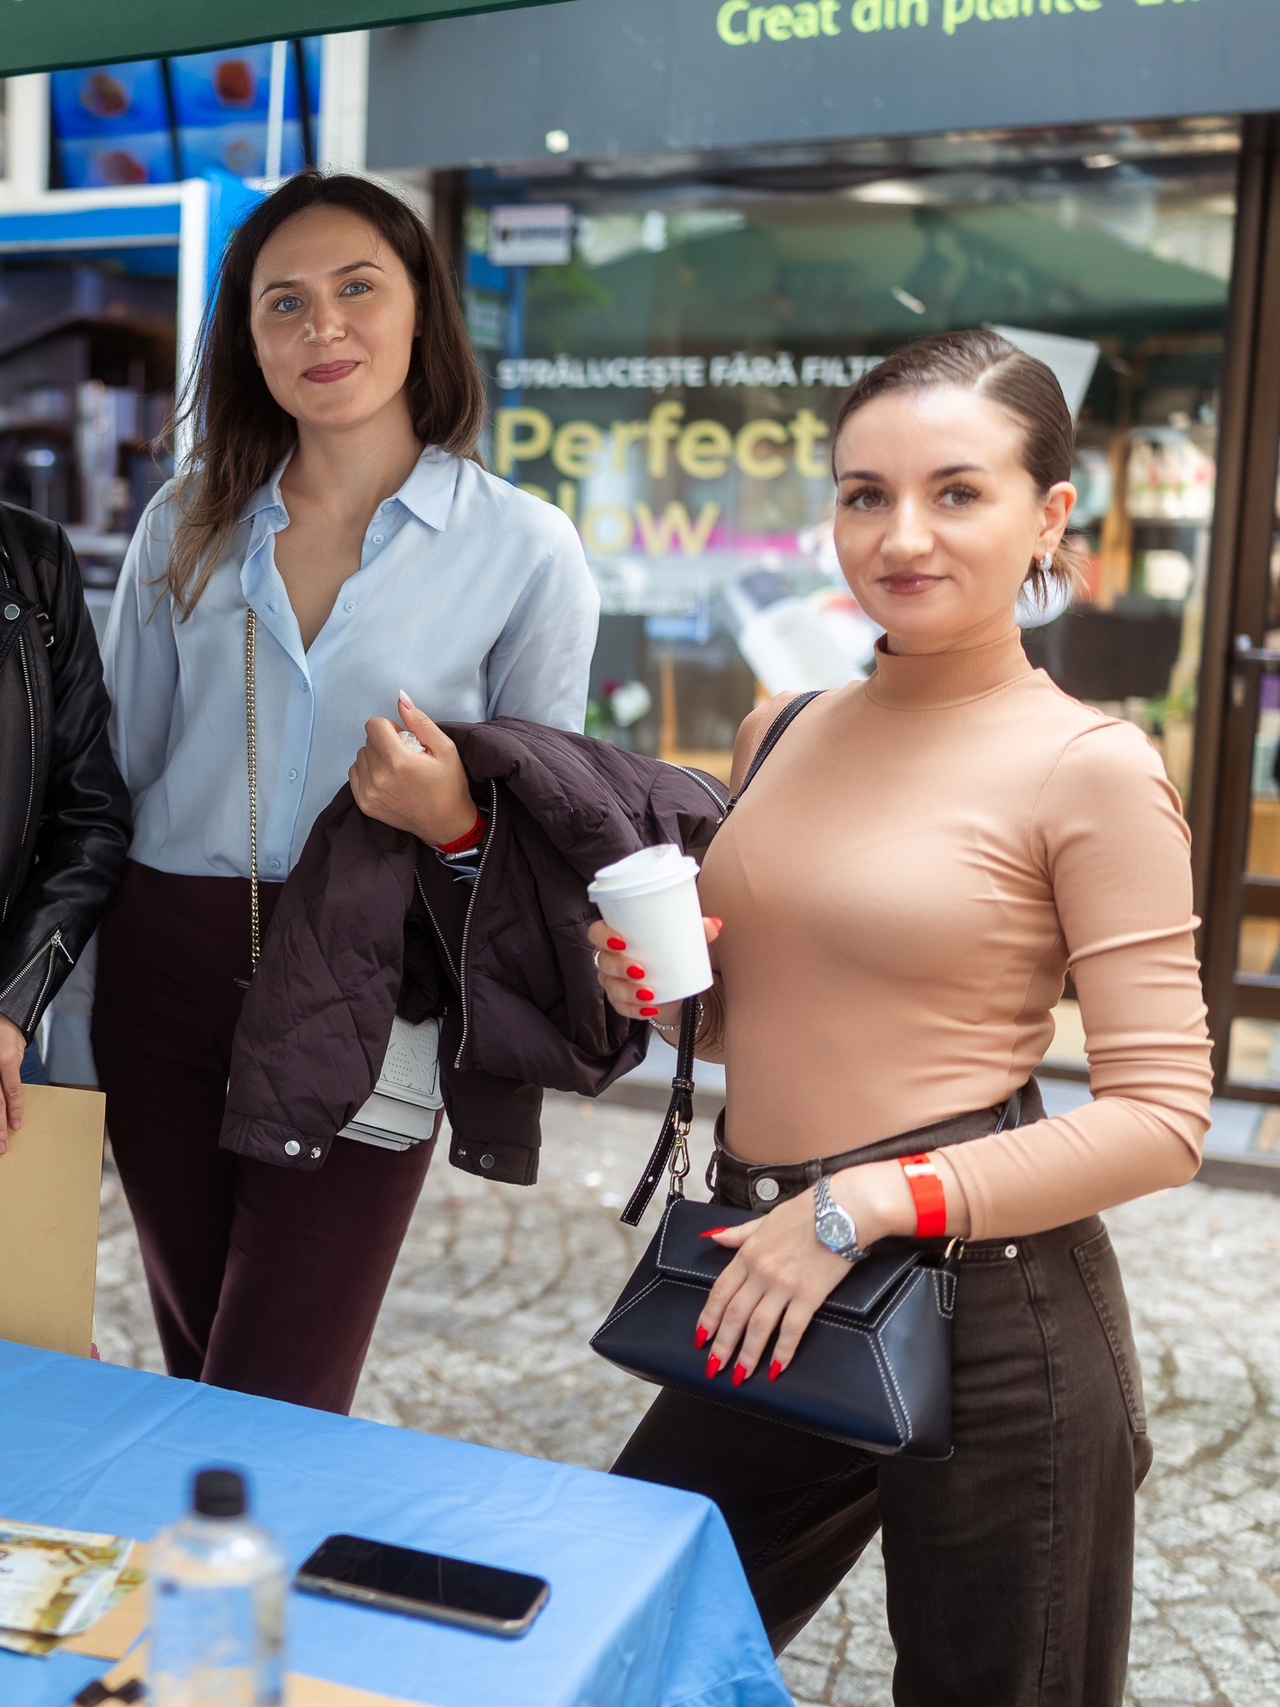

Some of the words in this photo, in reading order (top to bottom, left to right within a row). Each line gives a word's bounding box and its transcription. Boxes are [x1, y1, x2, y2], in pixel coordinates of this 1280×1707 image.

[716, 0, 842, 46] Creat
[708, 351, 798, 388] FĂRĂ
[495, 401, 831, 480] Perfect
[518, 481, 720, 557] low
